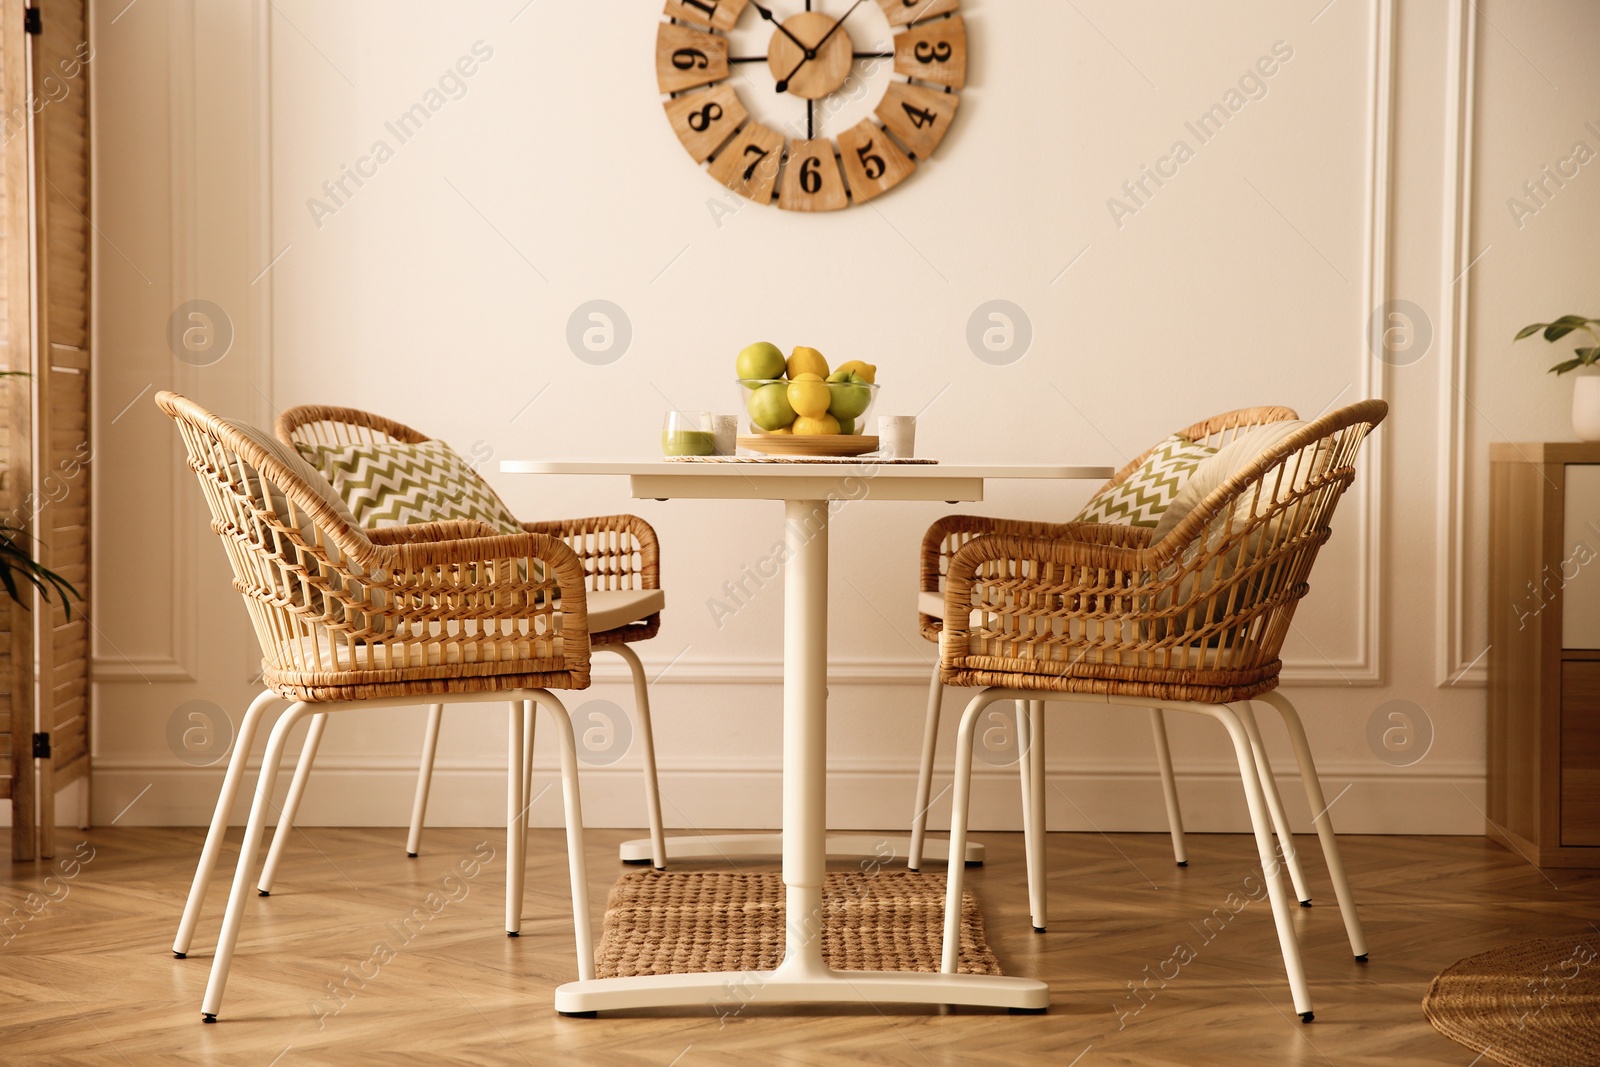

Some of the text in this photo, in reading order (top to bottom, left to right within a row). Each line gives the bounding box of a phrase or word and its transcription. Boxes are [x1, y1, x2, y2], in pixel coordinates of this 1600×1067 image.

[671, 47, 709, 71] 9
[914, 41, 952, 65] 3
[688, 102, 723, 133] 8
[901, 101, 938, 130] 4
[743, 144, 769, 181] 7
[856, 138, 886, 180] 5
[799, 156, 822, 194] 6
